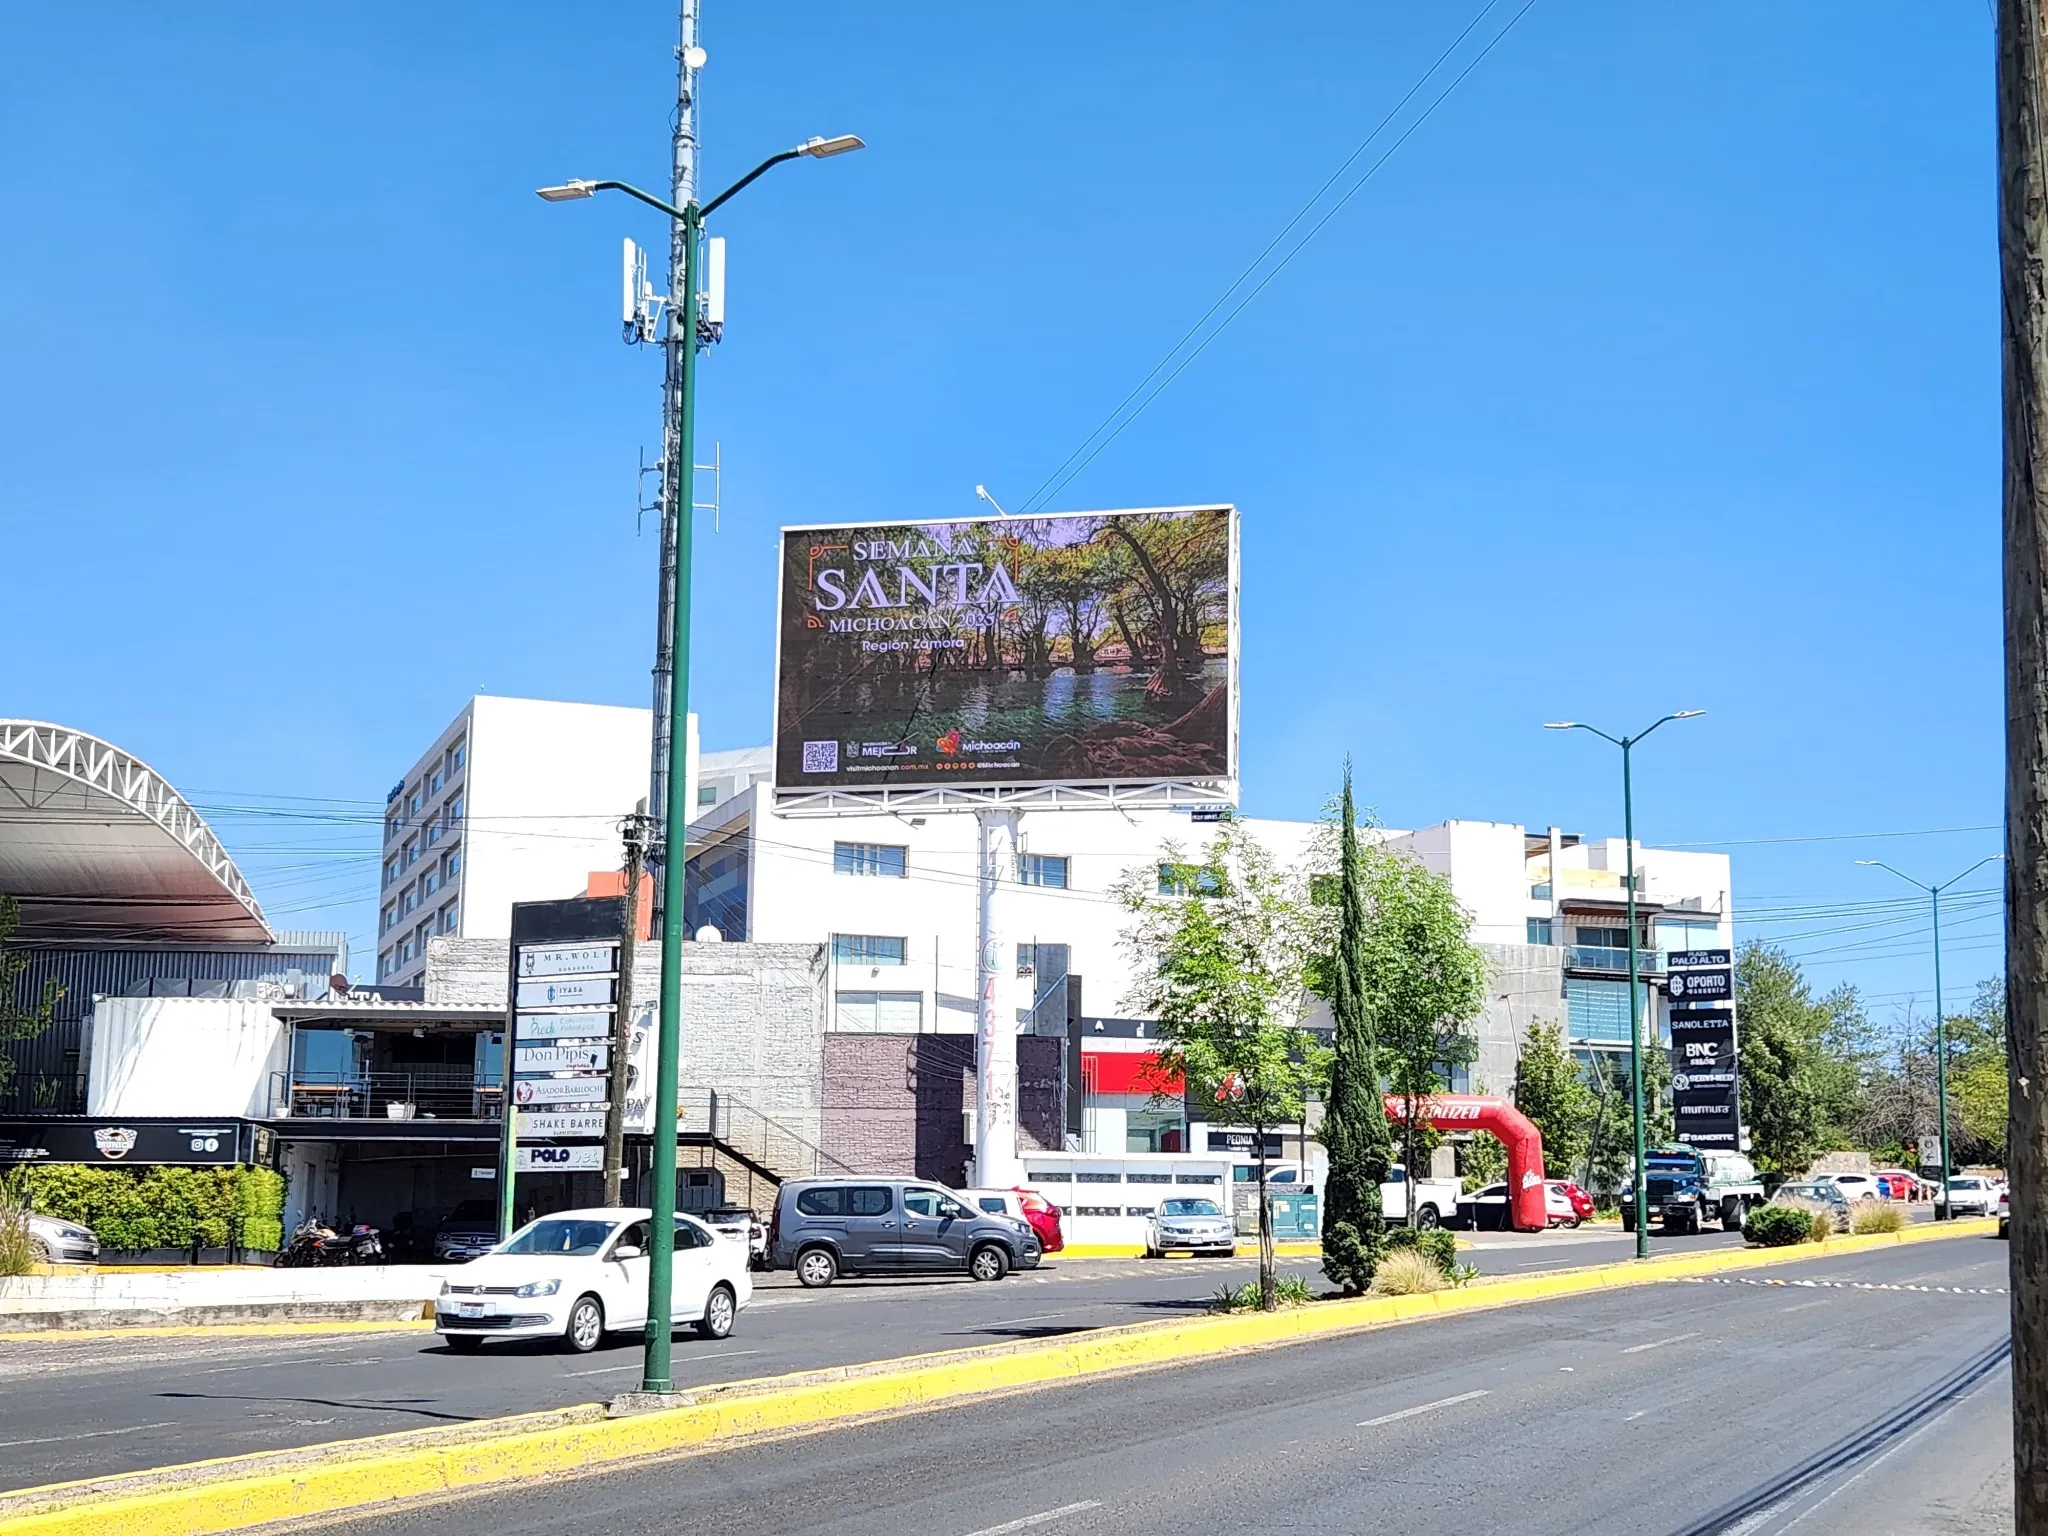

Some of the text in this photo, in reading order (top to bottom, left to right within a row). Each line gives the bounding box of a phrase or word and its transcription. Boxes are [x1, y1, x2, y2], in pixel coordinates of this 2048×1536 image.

[853, 538, 974, 561] SEMANA
[815, 562, 1023, 611] SANTA
[956, 611, 995, 628] 2025
[862, 638, 964, 653] Región Zamora
[963, 740, 1020, 752] Michoacán
[1671, 955, 1725, 965] PALO ALTO
[1687, 975, 1725, 988] OPORTO
[559, 986, 583, 994] IYASA
[524, 1047, 589, 1063] Don Pipis
[1685, 1043, 1719, 1057] BNC
[1681, 1105, 1729, 1114] murmura
[533, 1118, 603, 1129] SHAKE BARRE
[531, 1149, 570, 1163] POLO
